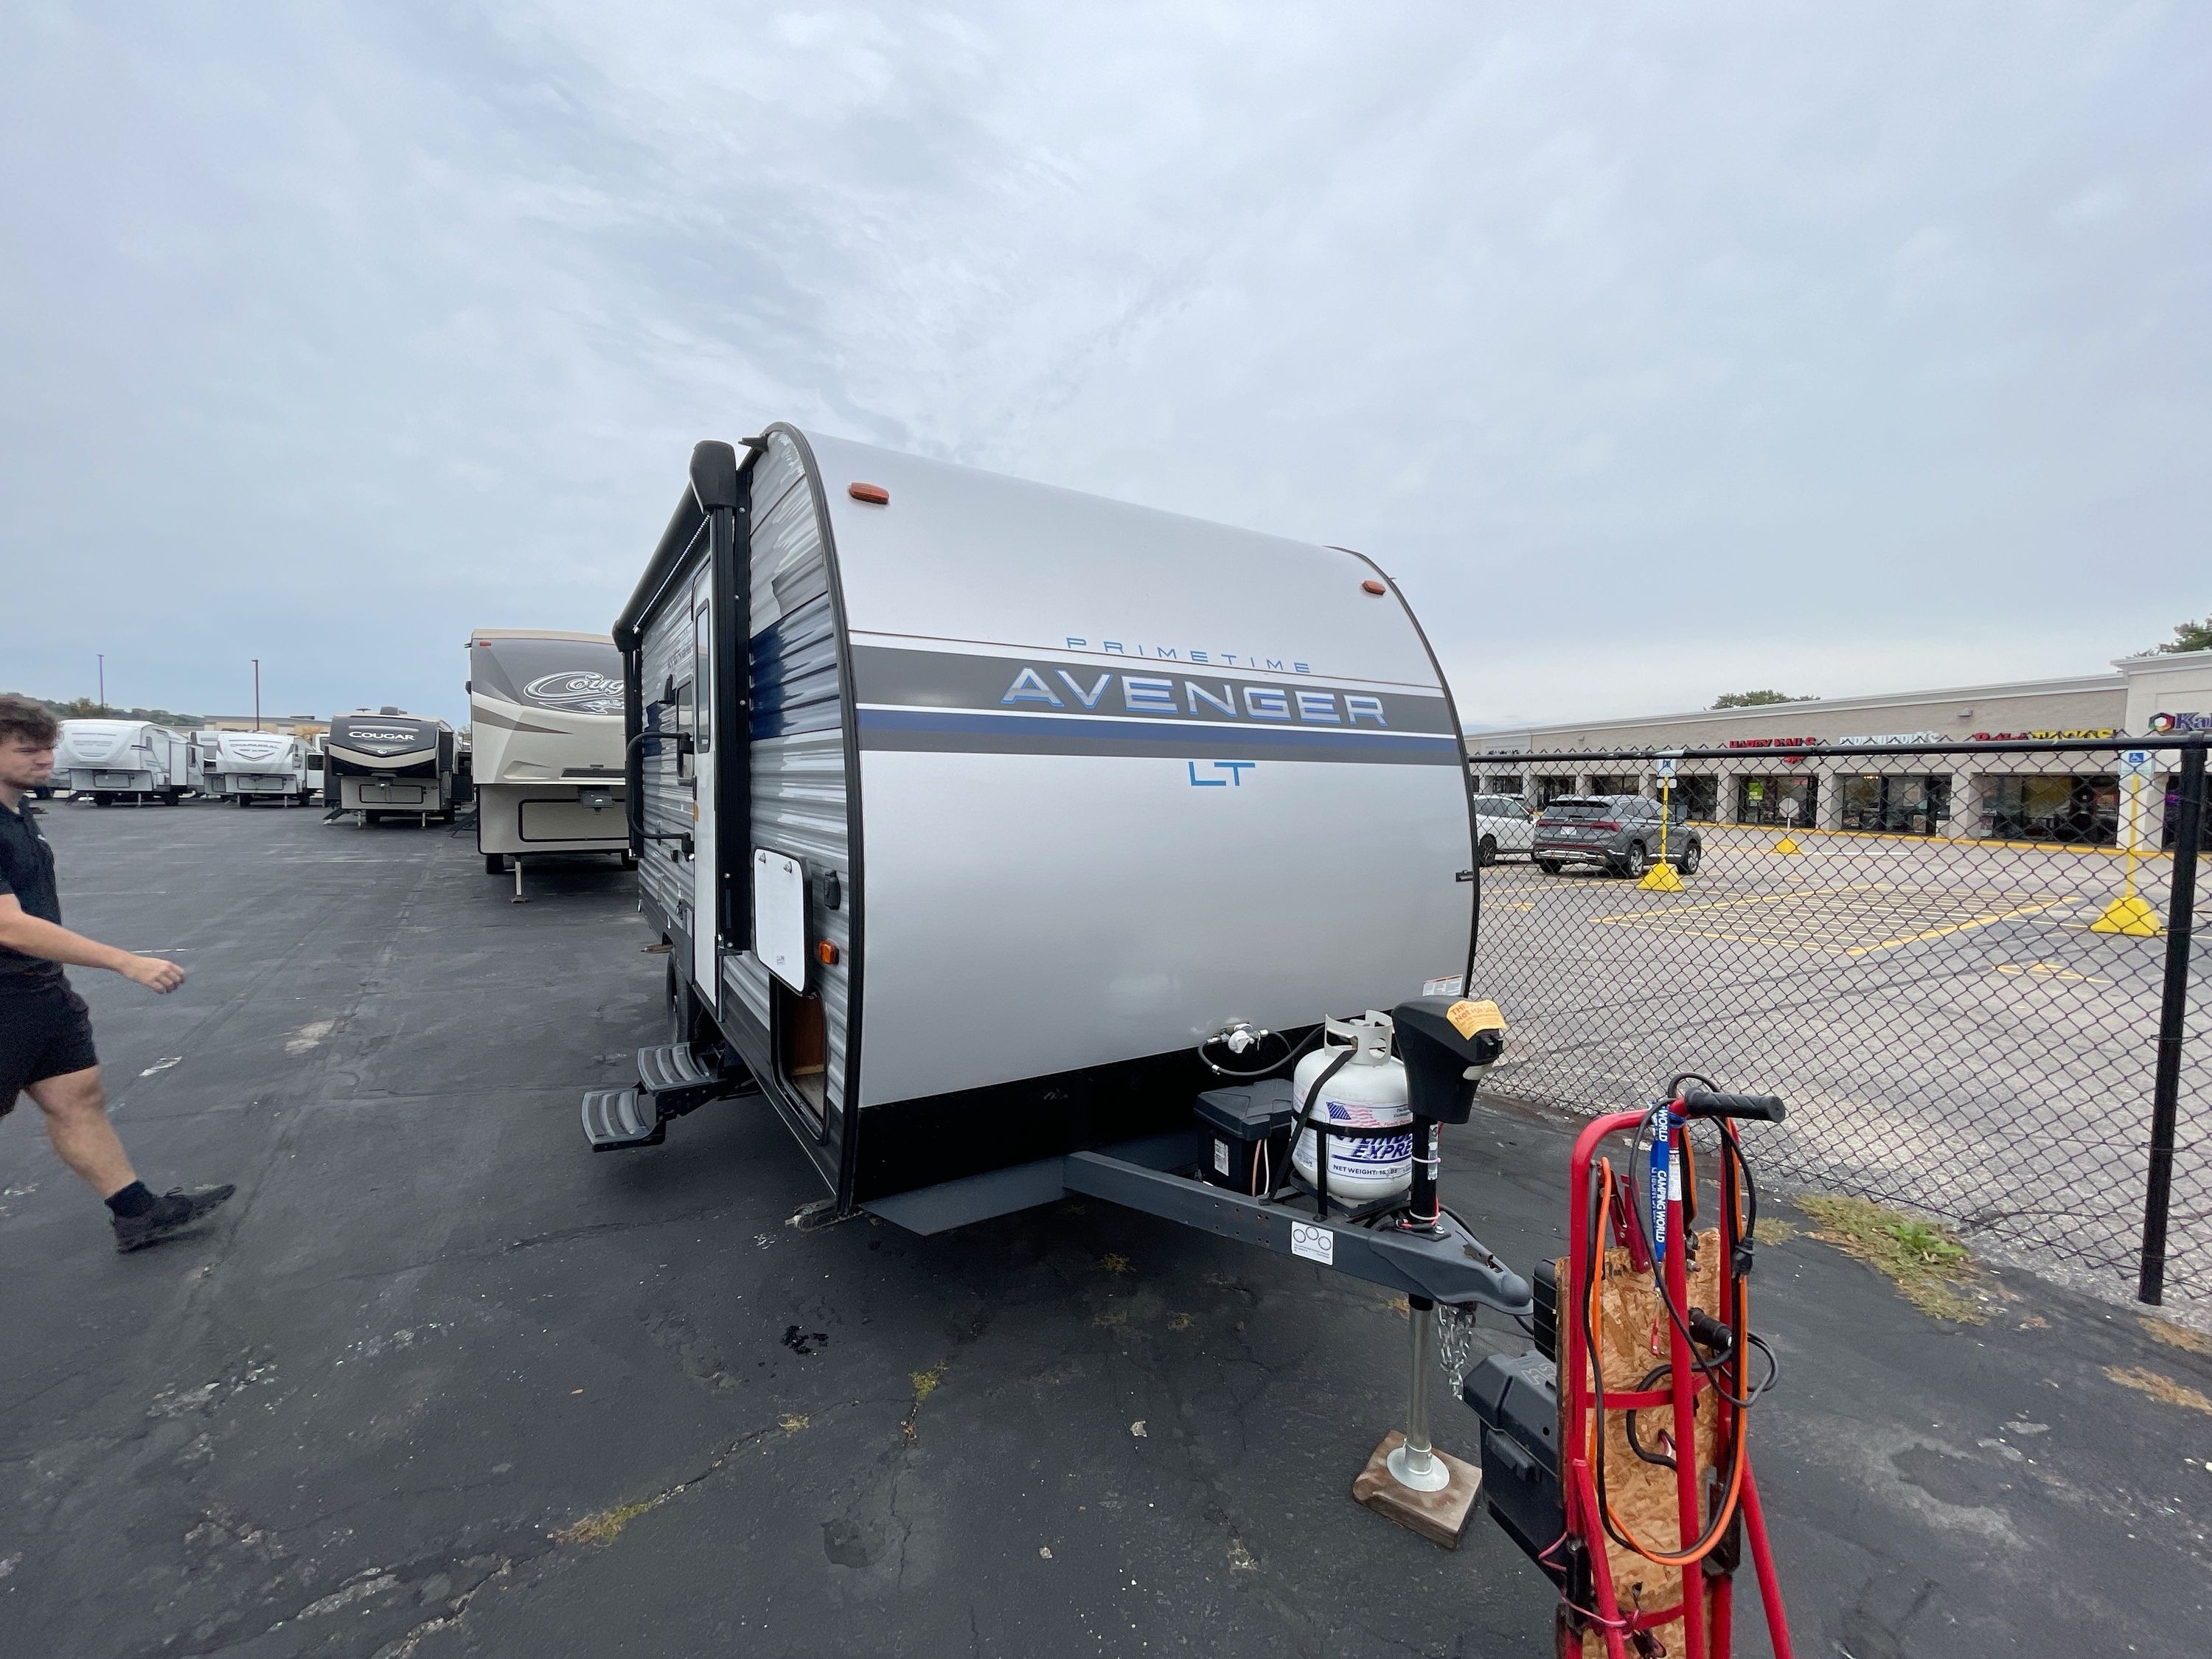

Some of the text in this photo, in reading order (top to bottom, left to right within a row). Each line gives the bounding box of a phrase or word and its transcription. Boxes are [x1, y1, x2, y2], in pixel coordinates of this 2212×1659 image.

[1066, 637, 1310, 673] PRIMETIME
[1001, 666, 1389, 727] AVENGER
[349, 731, 416, 741] COUGAR
[1189, 762, 1255, 786] LT
[1658, 1109, 1669, 1142] WORLD
[1333, 1164, 1346, 1173] NET
[1655, 1170, 1667, 1243] CAMPING WORLD
